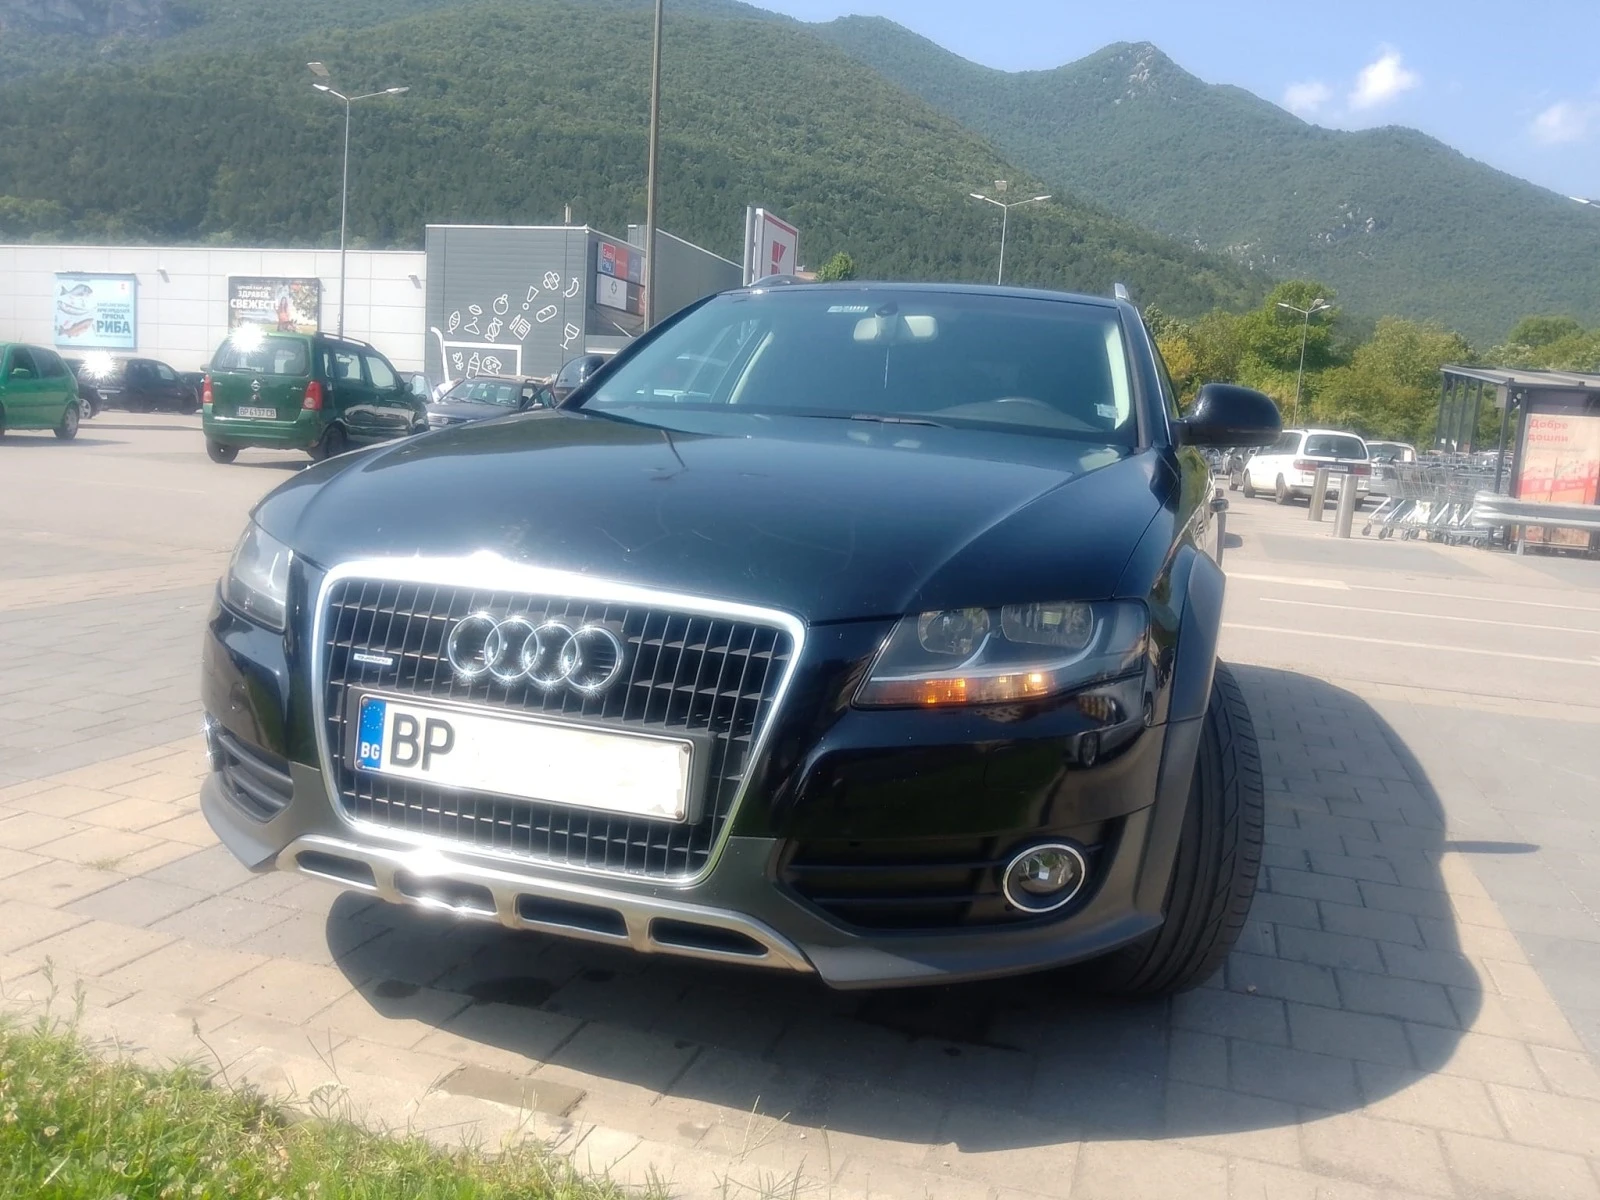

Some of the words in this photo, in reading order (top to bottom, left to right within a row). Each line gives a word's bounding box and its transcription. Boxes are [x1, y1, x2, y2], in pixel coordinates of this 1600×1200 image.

[602, 247, 615, 260] Easy
[602, 258, 612, 271] Pay
[230, 298, 279, 310] СВЕЖЕСТ!
[96, 320, 131, 334] РИБА
[1528, 419, 1569, 431] Добре
[1528, 433, 1569, 442] дошли
[360, 741, 380, 760] BG
[389, 711, 456, 772] BP
